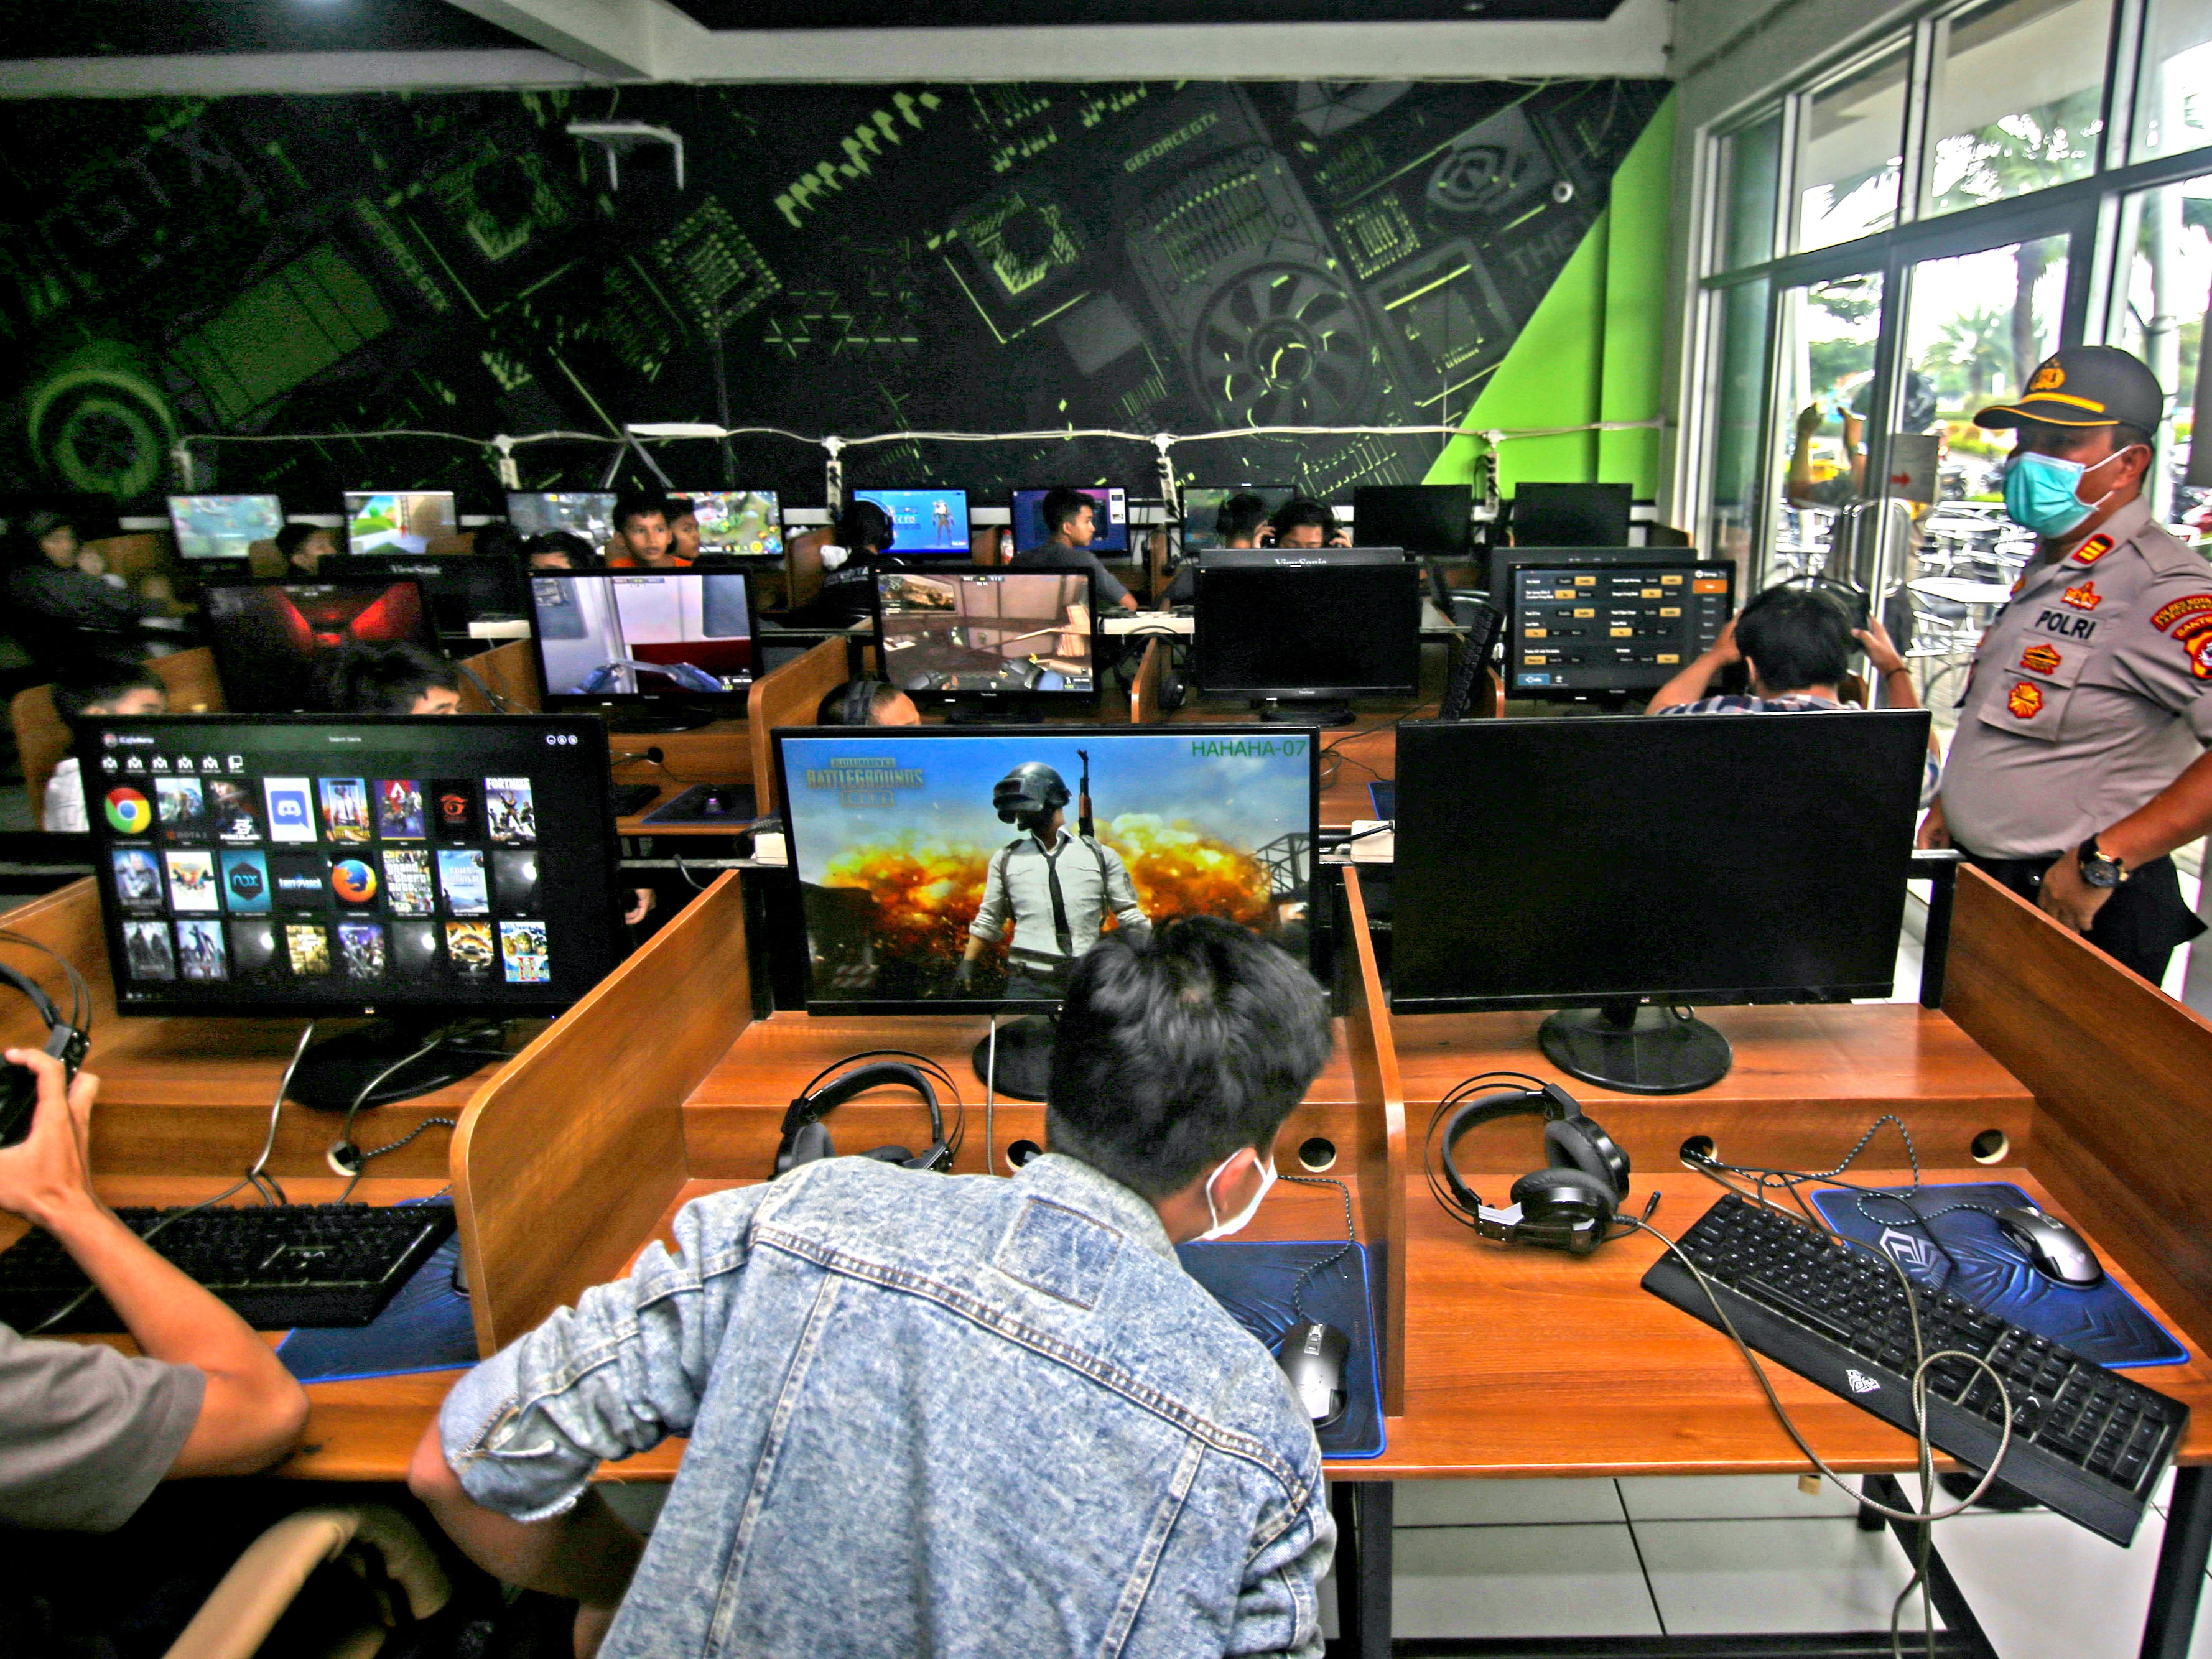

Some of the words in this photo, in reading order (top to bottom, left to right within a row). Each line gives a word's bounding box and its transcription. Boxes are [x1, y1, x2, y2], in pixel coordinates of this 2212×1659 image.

[2034, 610, 2096, 640] POLRI
[2176, 616, 2212, 637] BANTE
[1192, 740, 1306, 756] HAHAHA-07
[807, 769, 924, 789] BATTLEGROUNDS
